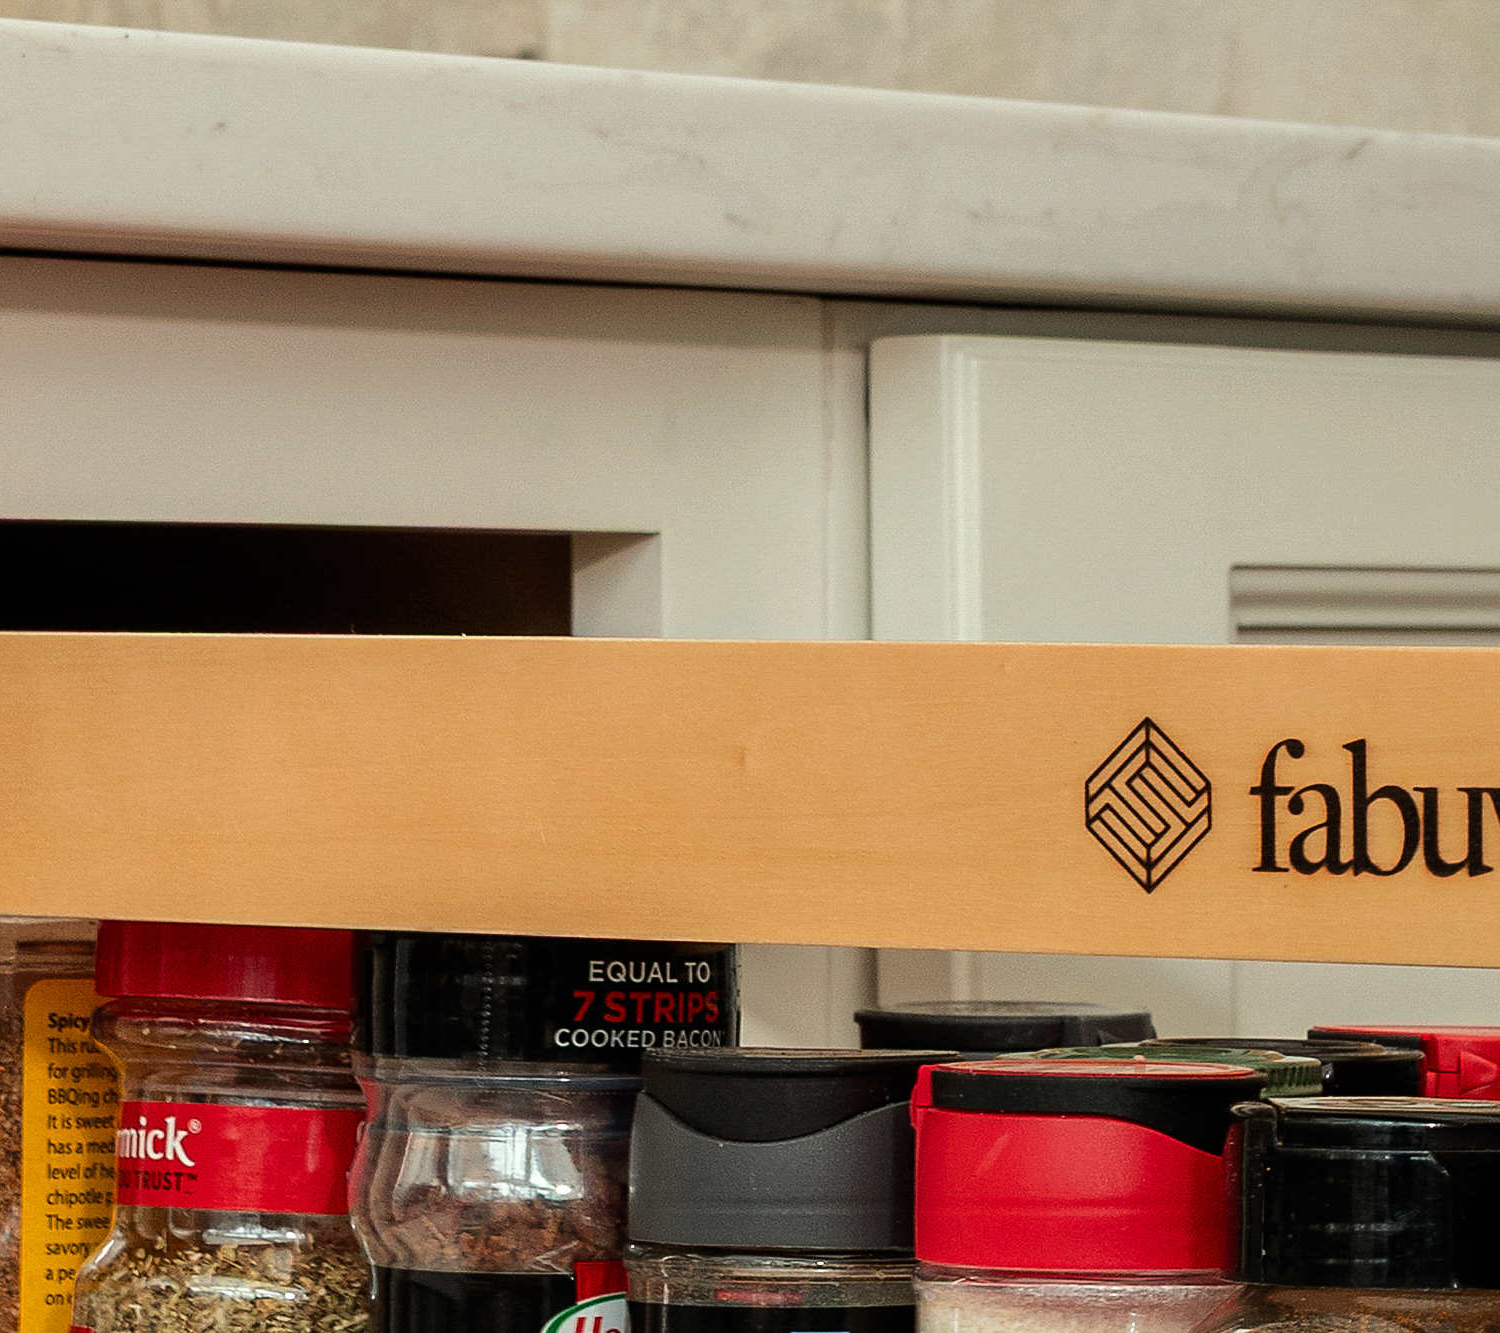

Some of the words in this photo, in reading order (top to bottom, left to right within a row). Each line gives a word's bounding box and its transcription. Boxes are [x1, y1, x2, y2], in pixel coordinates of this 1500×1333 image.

[588, 960, 678, 983] EQUAL
[685, 961, 711, 983] TO
[573, 990, 596, 1022] 7
[604, 990, 720, 1023] STRIPS
[47, 1012, 91, 1032] Spicy
[554, 1028, 656, 1048] COOKED
[48, 1088, 100, 1108] BBQing
